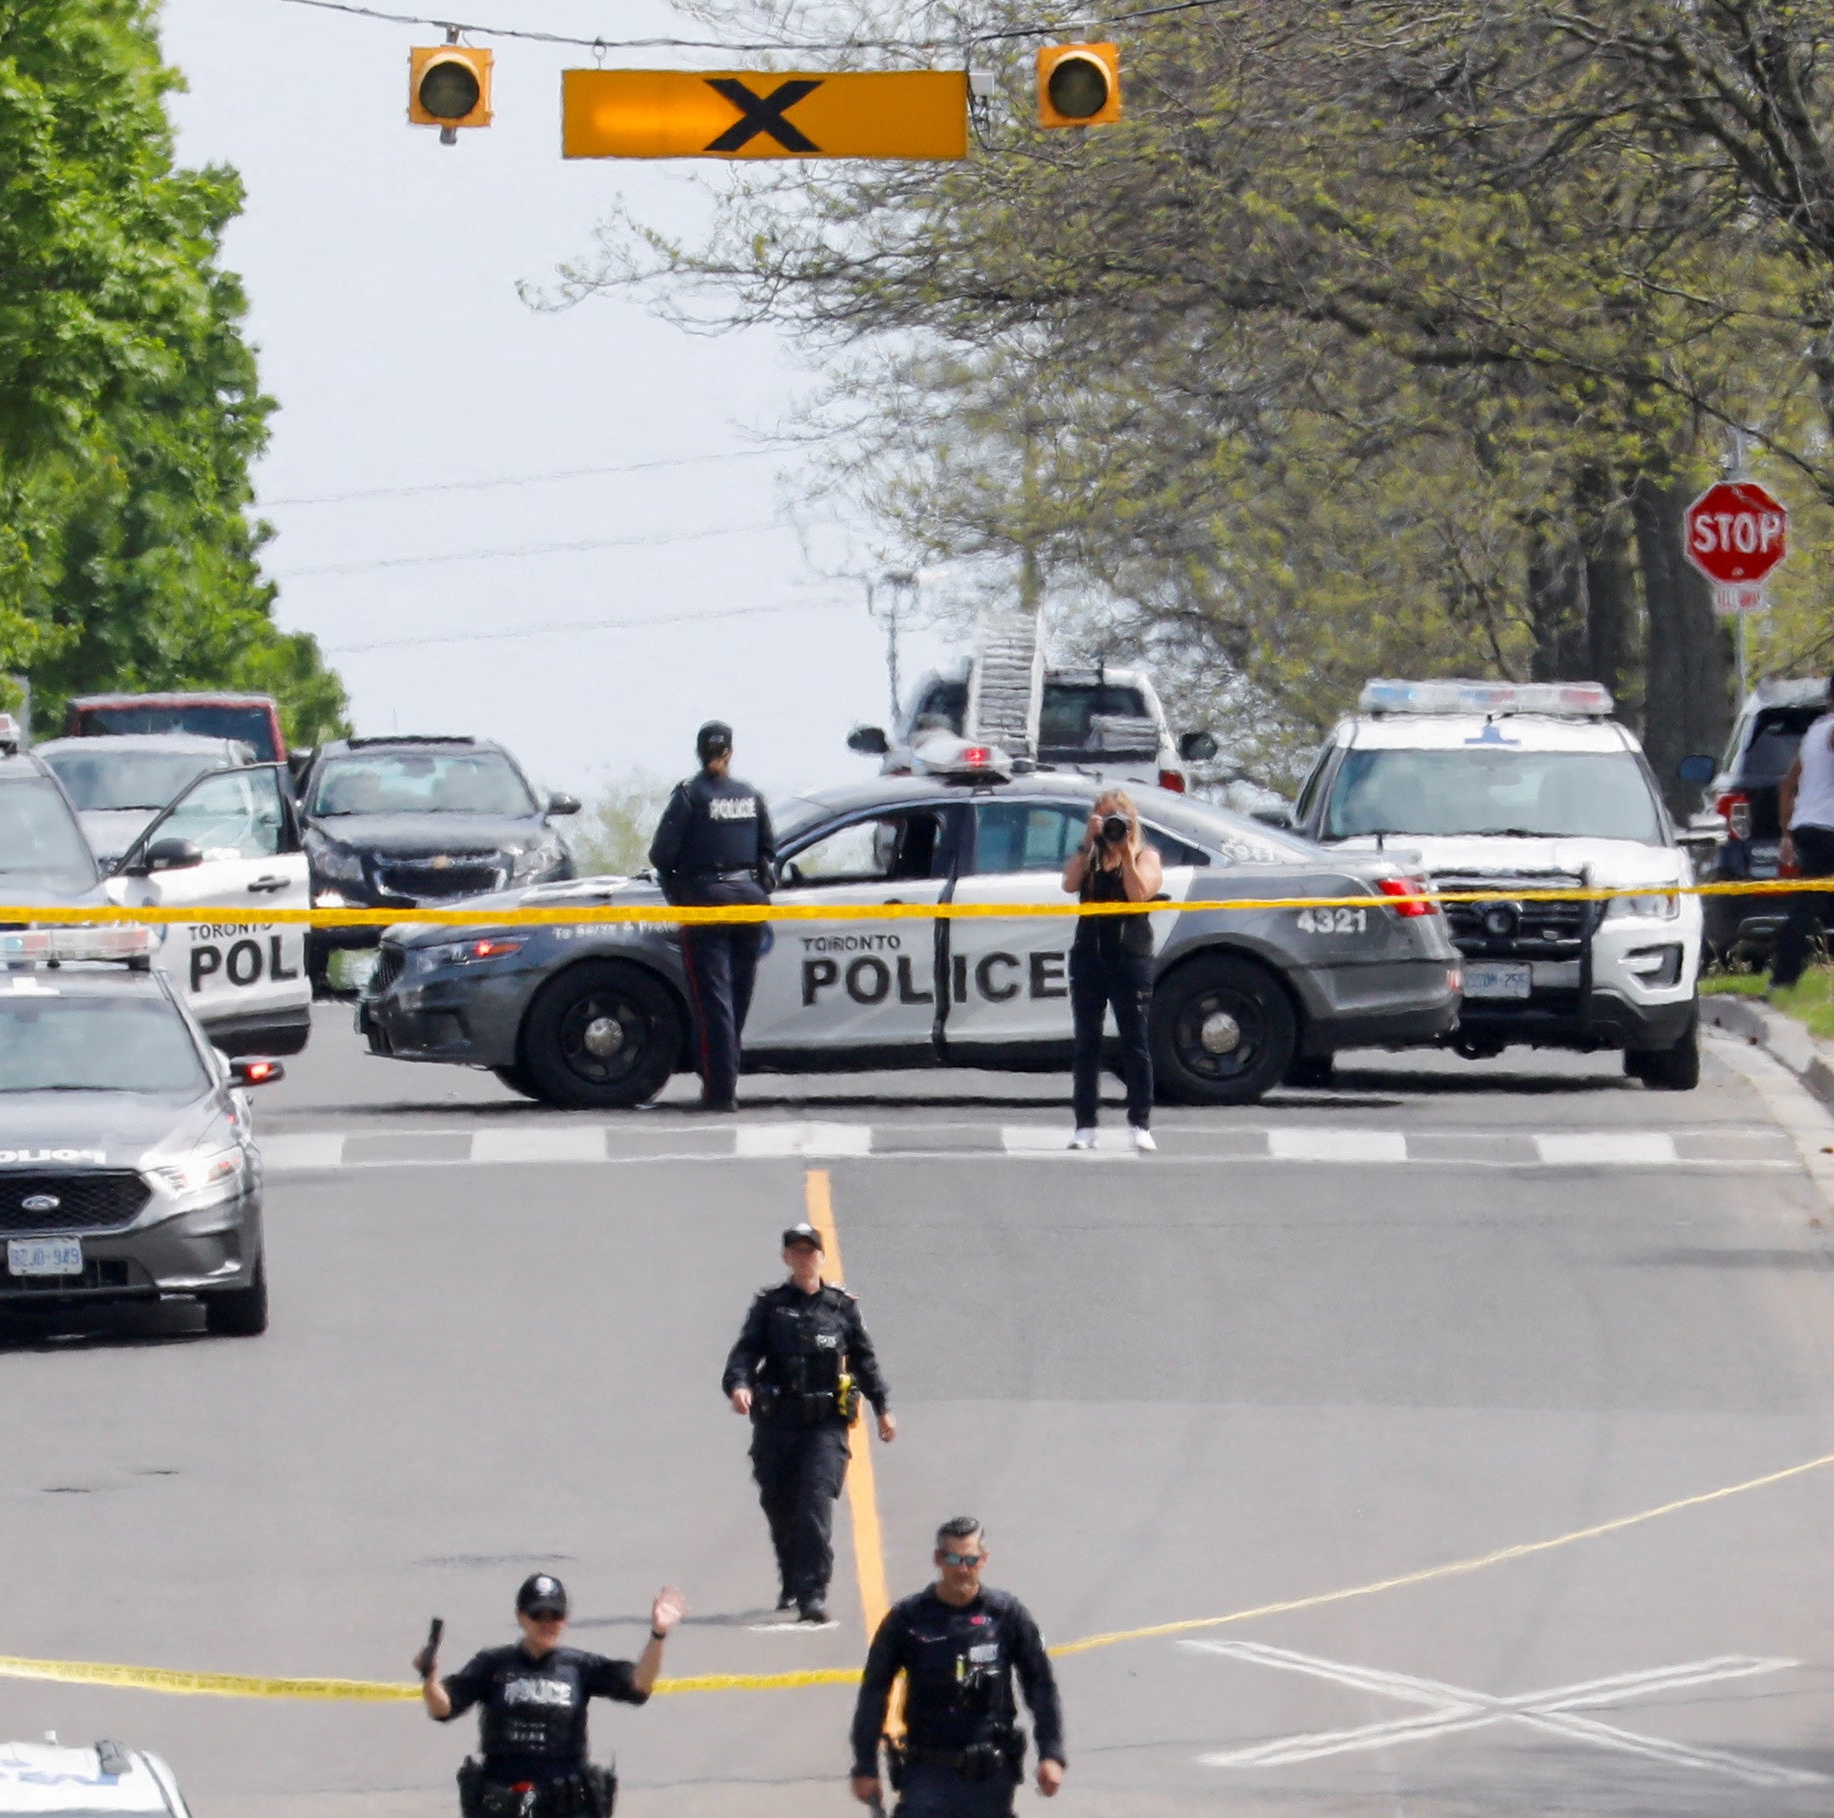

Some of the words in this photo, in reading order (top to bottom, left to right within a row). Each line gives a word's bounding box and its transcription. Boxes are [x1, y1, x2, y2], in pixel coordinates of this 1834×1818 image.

[1693, 513, 1781, 554] STOP
[708, 797, 757, 820] POLICE
[1297, 909, 1367, 934] 4321
[801, 934, 901, 953] TORONTO
[801, 951, 1068, 1006] POLICE
